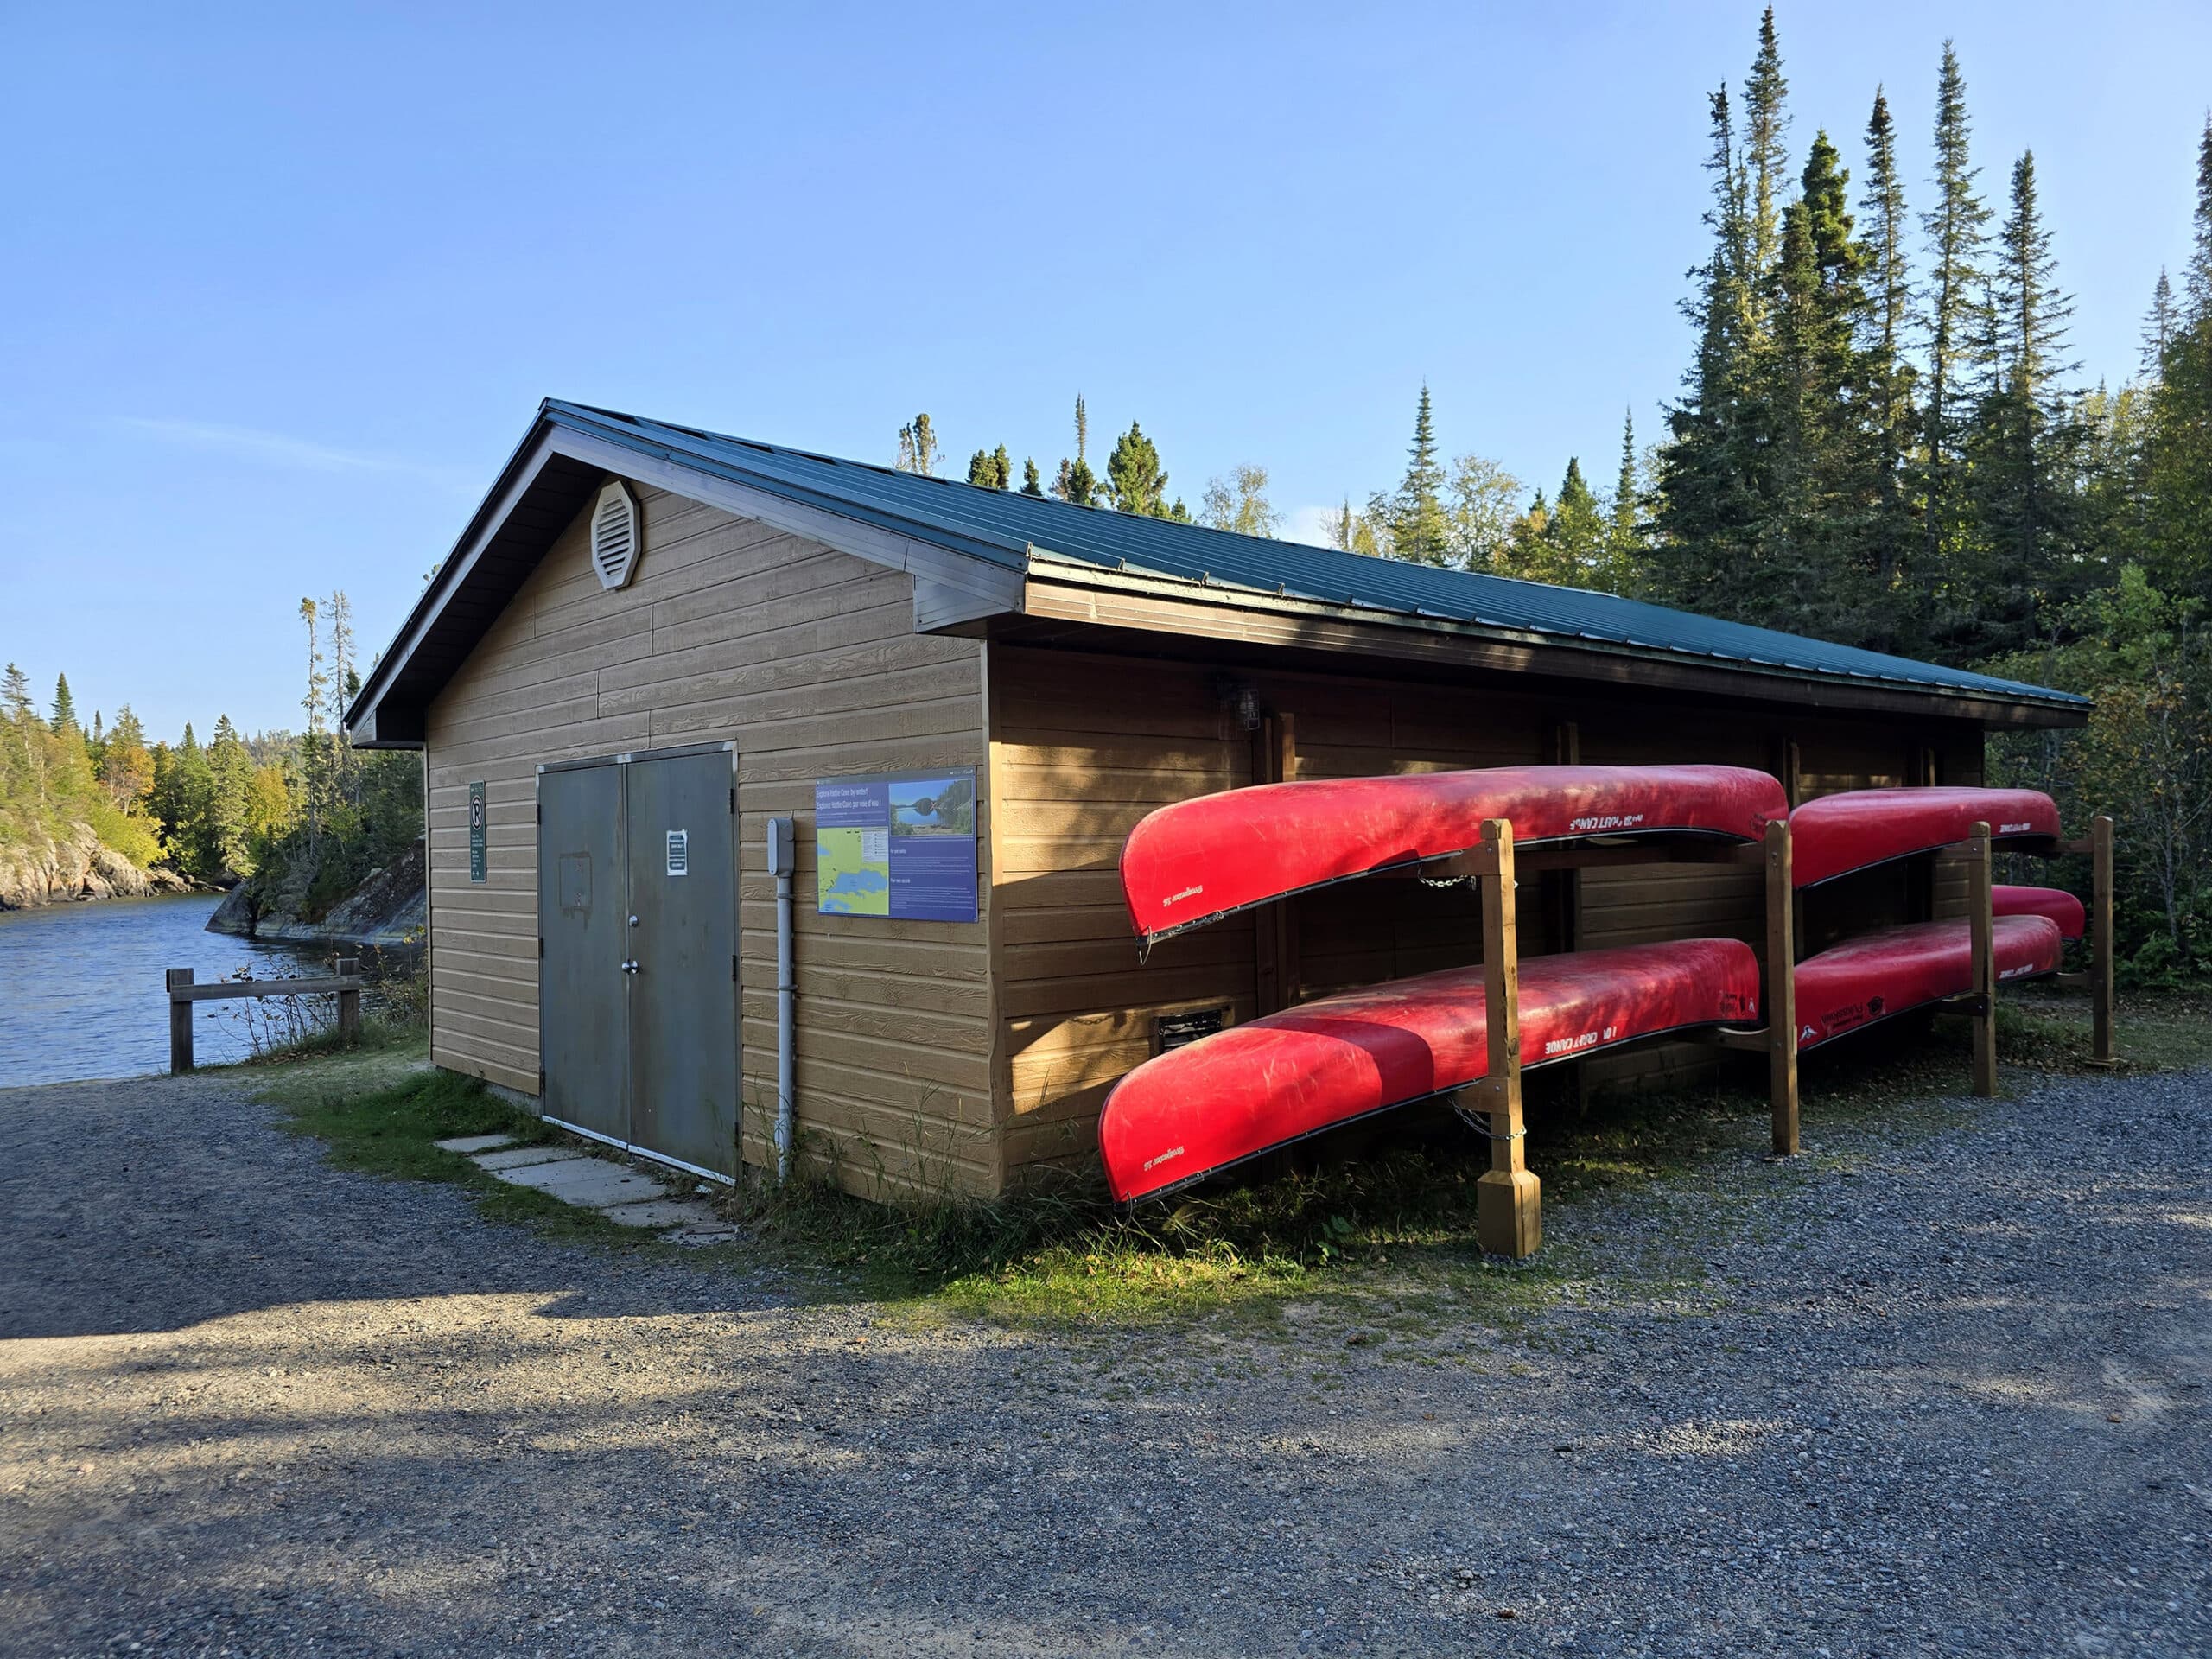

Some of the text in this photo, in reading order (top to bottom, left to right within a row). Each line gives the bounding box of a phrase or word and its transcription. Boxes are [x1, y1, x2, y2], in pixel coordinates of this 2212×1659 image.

[841, 788, 850, 797] Cove
[850, 788, 855, 797] by
[842, 800, 852, 809] Cove
[1545, 1037, 1573, 1054] CANOE
